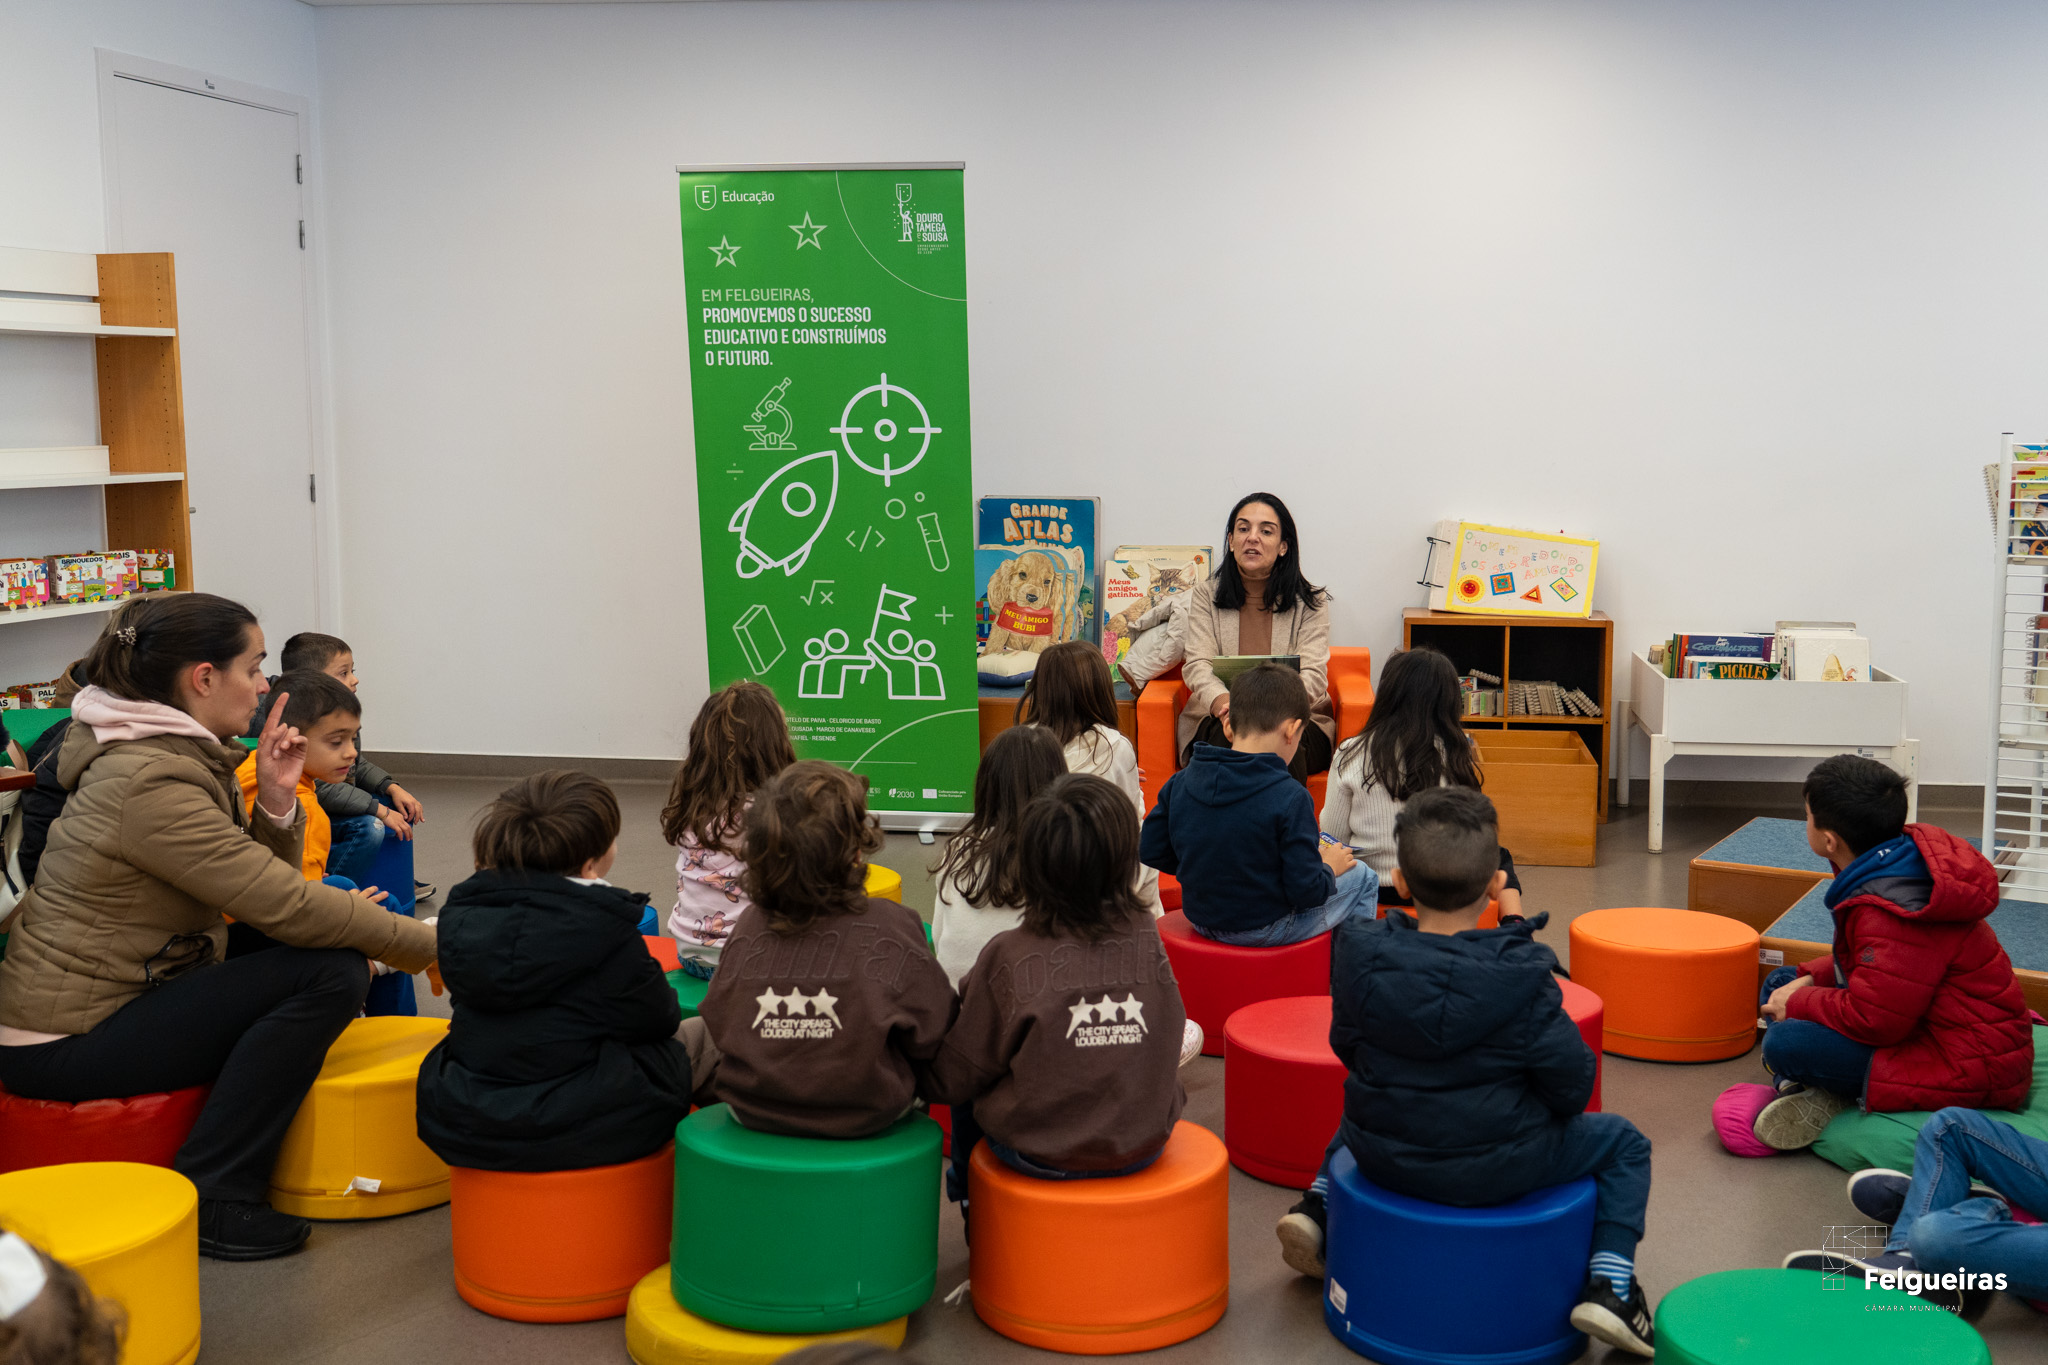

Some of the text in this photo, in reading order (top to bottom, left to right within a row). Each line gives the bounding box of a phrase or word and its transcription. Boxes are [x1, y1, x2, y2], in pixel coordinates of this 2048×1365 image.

[722, 190, 775, 205] Educação
[916, 212, 943, 222] DOURO
[922, 232, 948, 242] SOUSA
[702, 288, 814, 303] EM FELGUEIRAS,
[703, 307, 872, 323] PROMOVEMOS O SUCESSO
[704, 325, 887, 345] EDUCATIVO E CONSTRUÍMOS
[705, 350, 773, 366] O FUTURO.
[1010, 503, 1068, 520] GRANDE
[1003, 517, 1073, 543] ATLAS
[62, 556, 103, 564] BRINQUEDOS
[1520, 550, 1584, 572] REDONDO
[1492, 560, 1517, 574] SEUS
[1524, 565, 1575, 580] AMIGOS
[1005, 609, 1021, 620] MEU
[1013, 621, 1036, 632] BUBI
[1719, 664, 1769, 680] PICKLES
[764, 1018, 832, 1029] THE CITY SPEAKS
[1077, 1024, 1140, 1037] THE CITY SPEAKS
[761, 1028, 834, 1038] LOUDER AT NIGHT
[1075, 1034, 1142, 1047] LOUDER AT NIGHT
